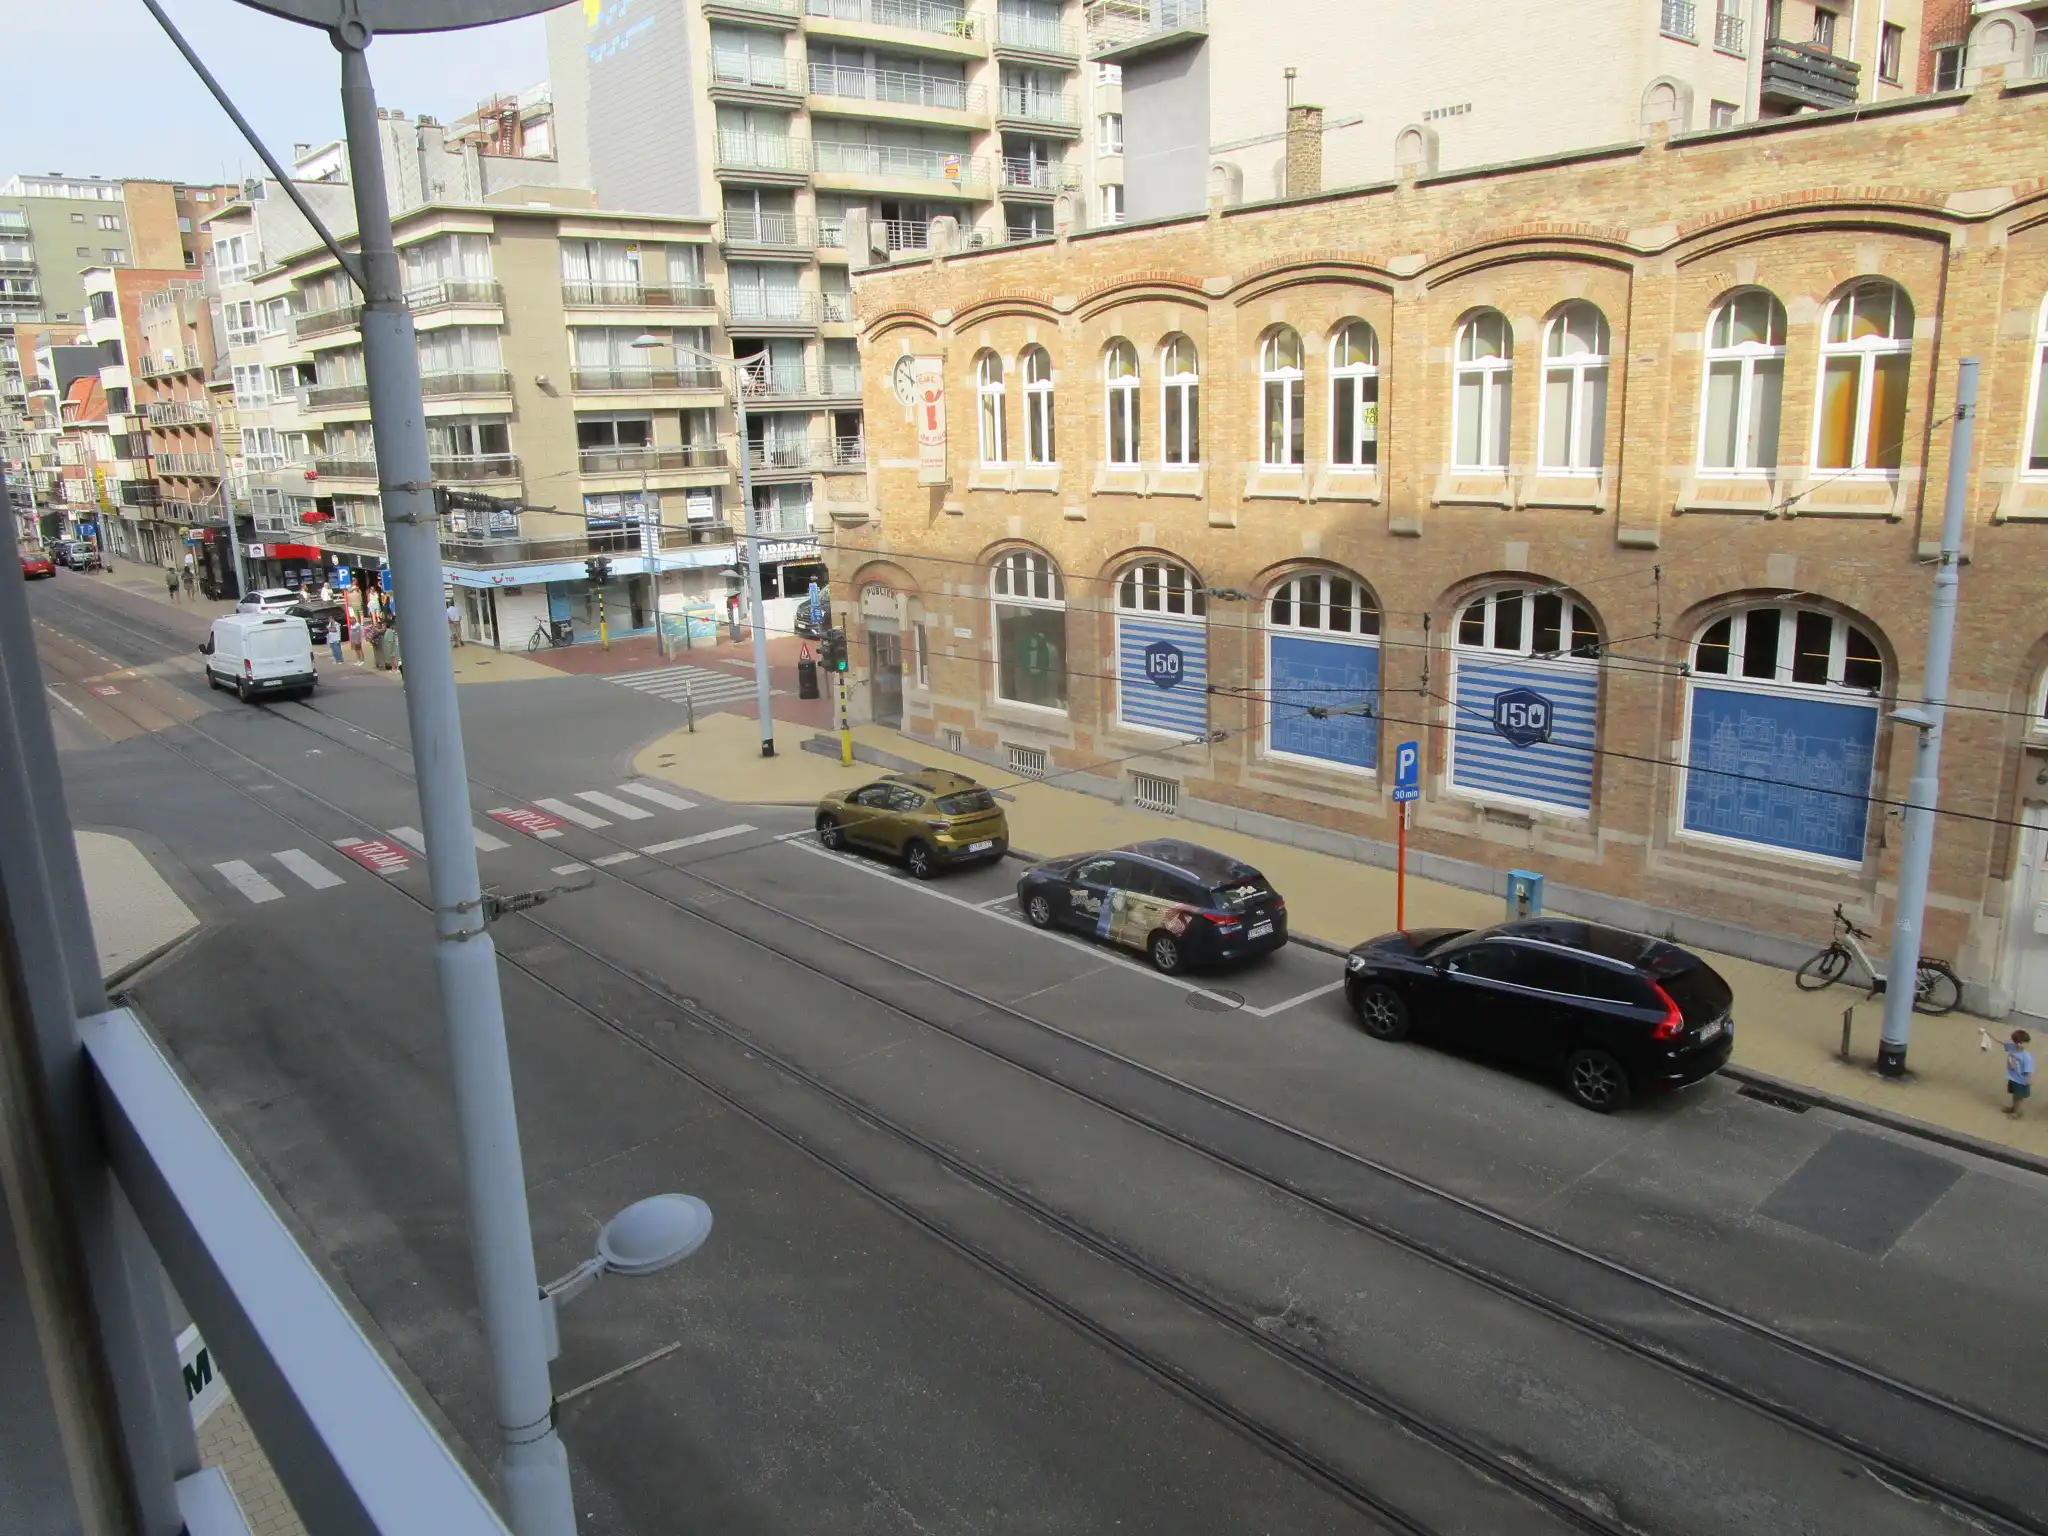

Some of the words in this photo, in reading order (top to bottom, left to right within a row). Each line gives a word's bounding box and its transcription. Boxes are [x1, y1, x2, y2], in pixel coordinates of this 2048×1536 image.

[1150, 653, 1179, 674] 150
[1500, 702, 1546, 729] 150
[1400, 749, 1415, 779] P
[498, 808, 557, 831] TRAM
[352, 841, 409, 868] TRAM
